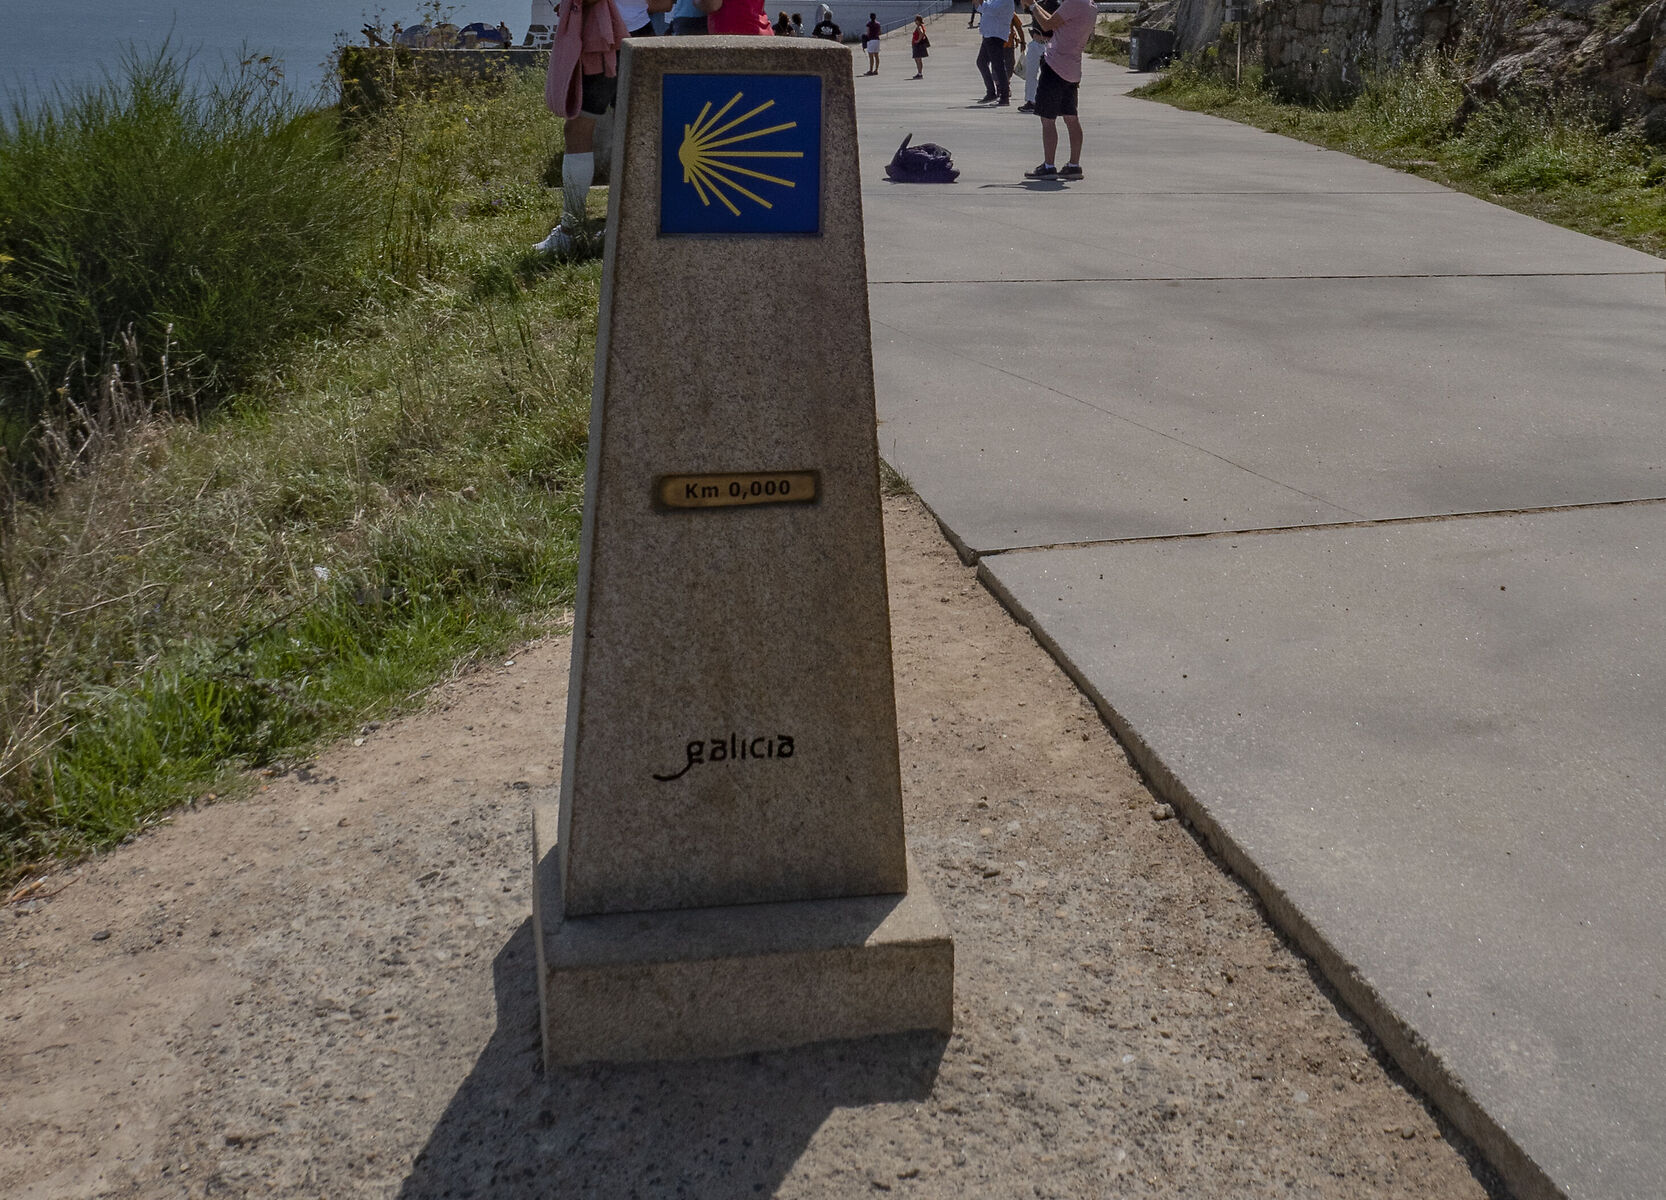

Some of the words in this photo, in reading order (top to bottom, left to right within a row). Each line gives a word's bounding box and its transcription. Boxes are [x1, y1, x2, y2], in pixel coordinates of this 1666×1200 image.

[685, 483, 719, 498] Km
[729, 480, 791, 500] 0,000
[652, 732, 795, 782] galicia
